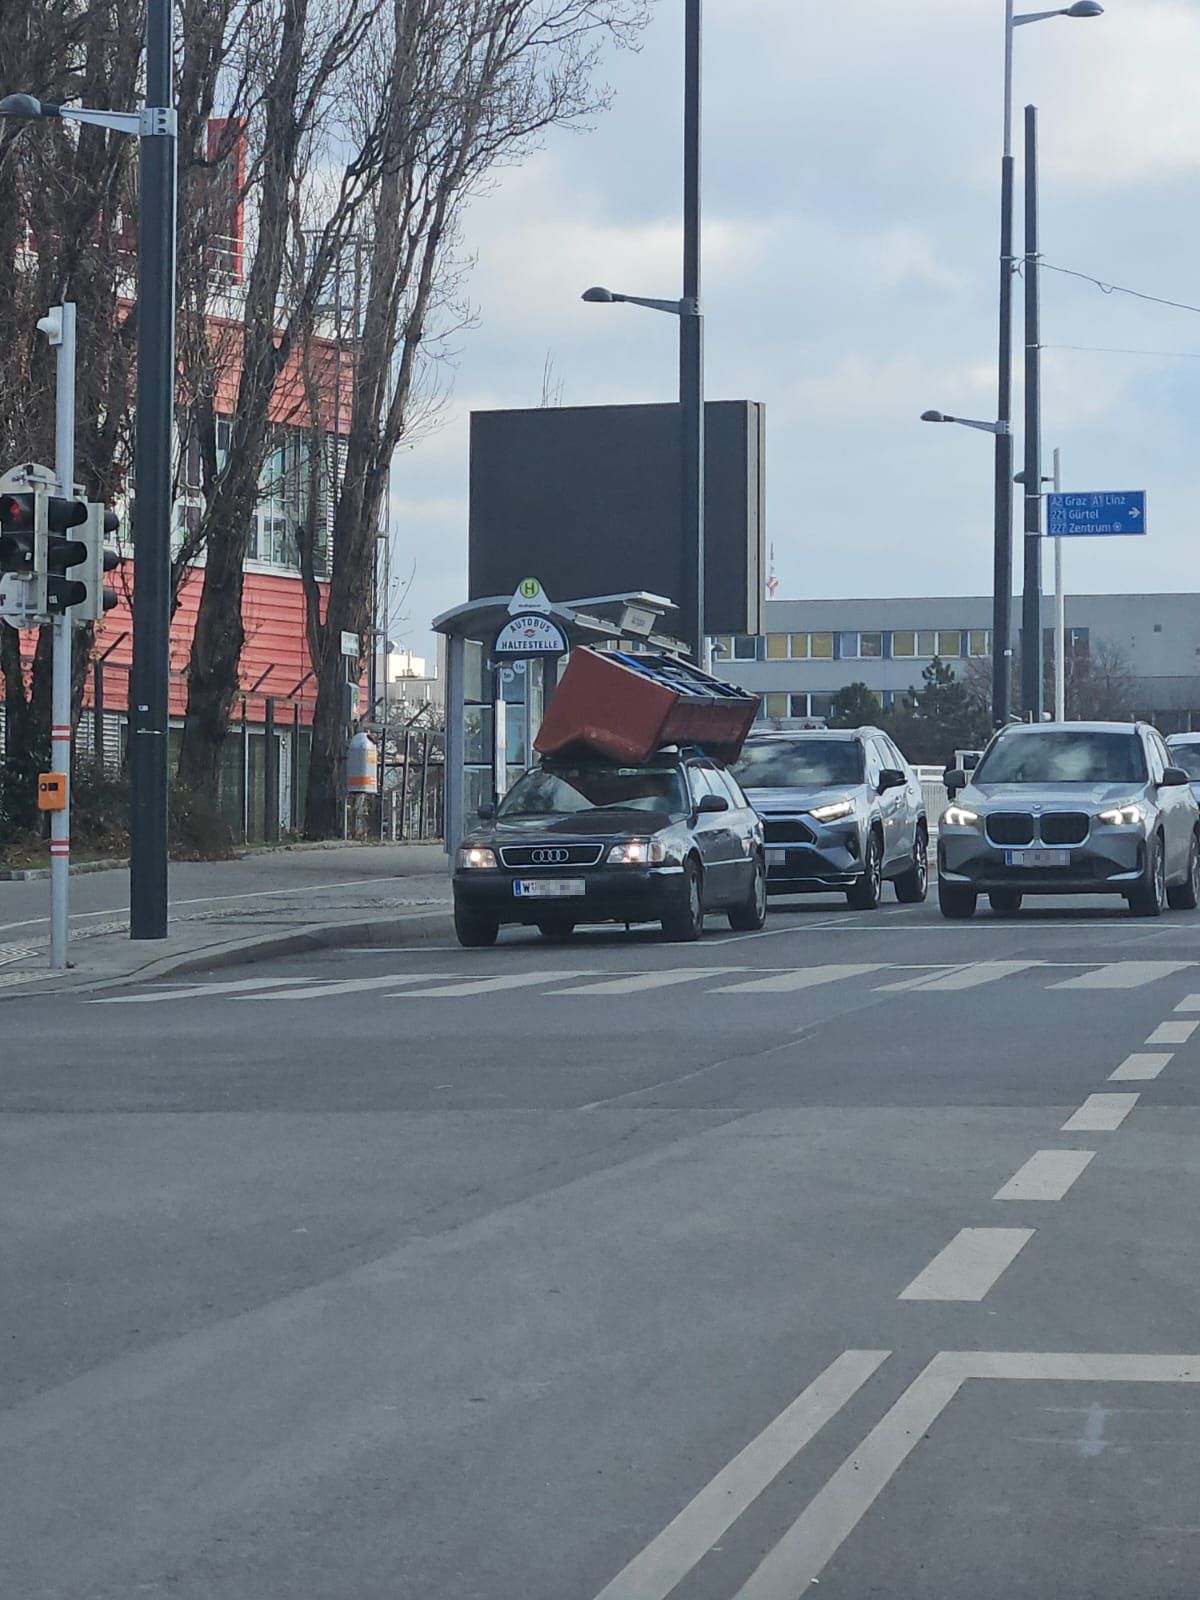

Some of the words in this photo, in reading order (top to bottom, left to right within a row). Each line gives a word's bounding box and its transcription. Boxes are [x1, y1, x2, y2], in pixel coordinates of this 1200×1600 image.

[1065, 495, 1087, 506] Graz
[1092, 495, 1102, 505] A1
[1105, 495, 1126, 505] Linz
[1052, 510, 1067, 520] 221
[1068, 509, 1099, 520] Gürtel
[1069, 522, 1111, 533] Zentrum
[524, 582, 535, 595] H
[510, 618, 552, 633] AUTOBUS
[502, 640, 558, 649] HALTESTELLE
